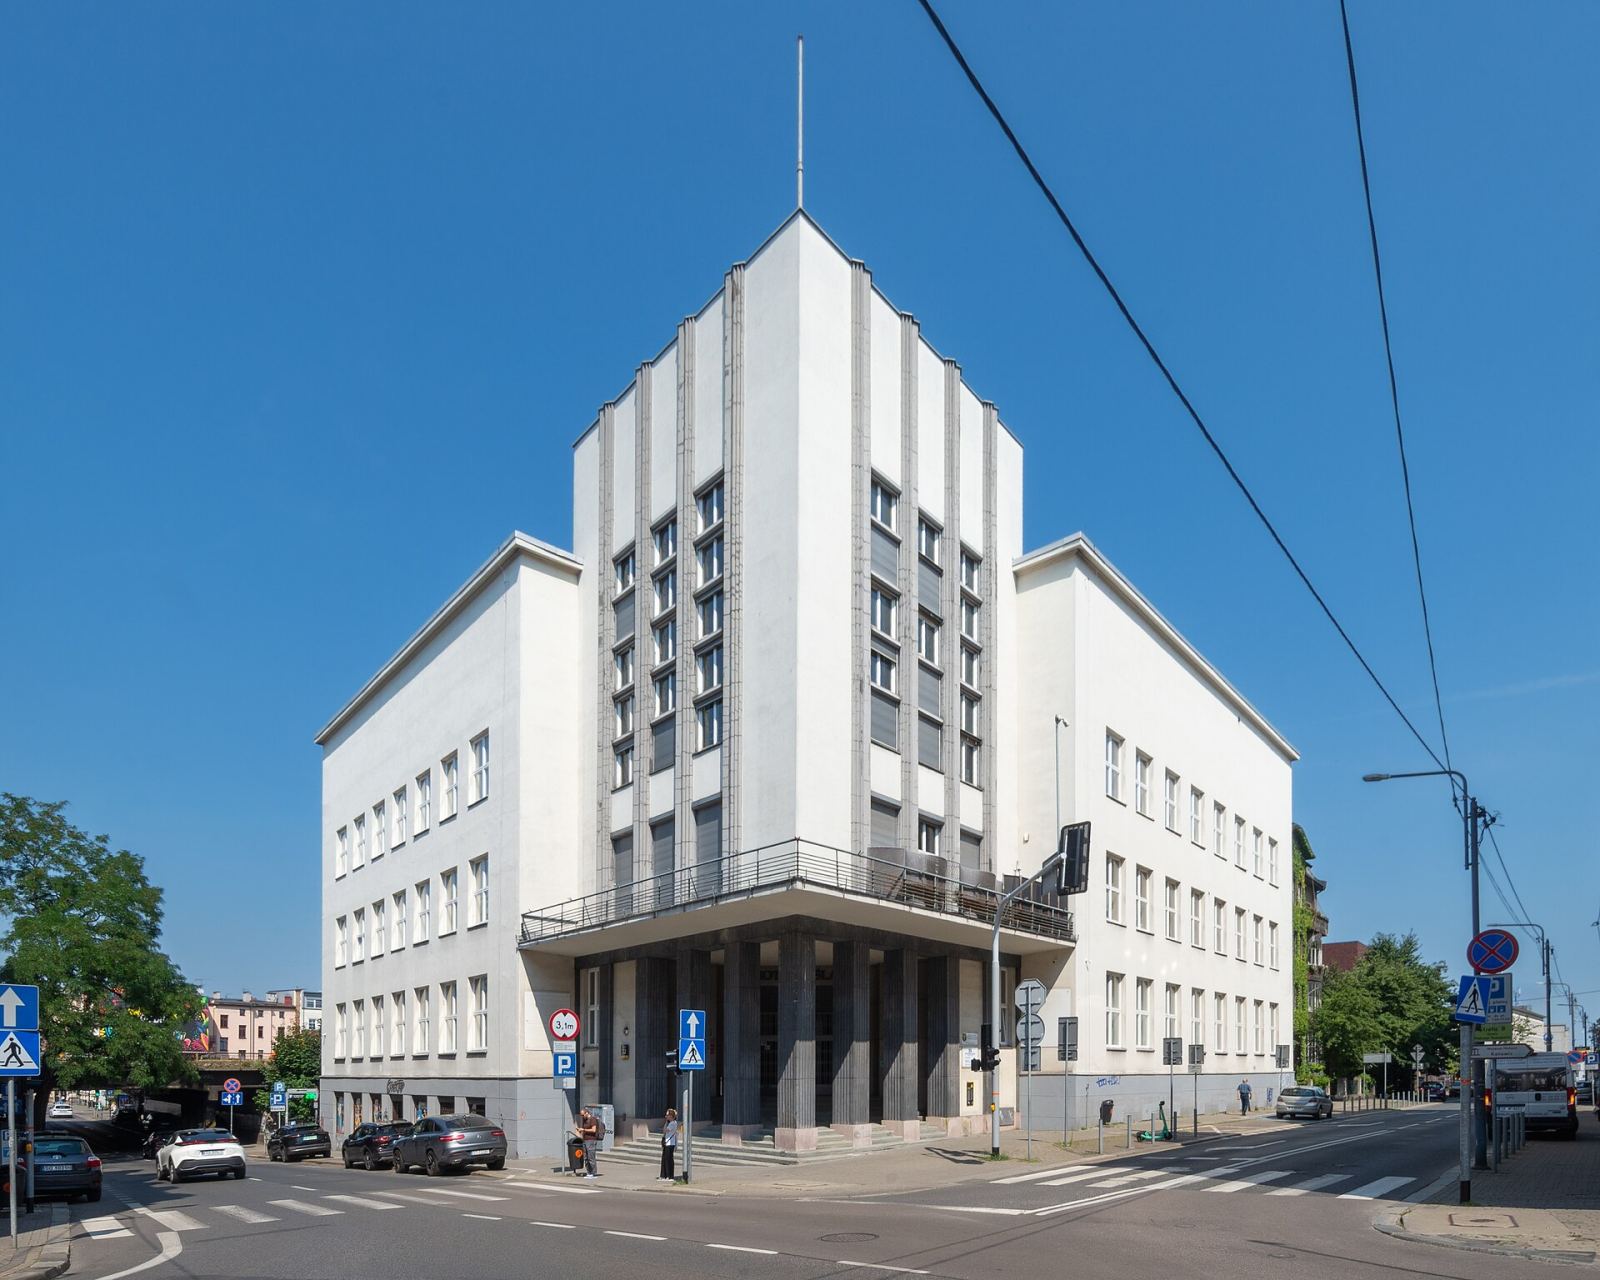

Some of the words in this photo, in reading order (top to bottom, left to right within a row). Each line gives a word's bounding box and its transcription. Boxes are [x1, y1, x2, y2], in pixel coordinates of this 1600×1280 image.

[1588, 1055, 1596, 1064] P
[558, 1056, 572, 1074] P
[276, 1083, 283, 1091] P
[274, 1094, 282, 1104] P
